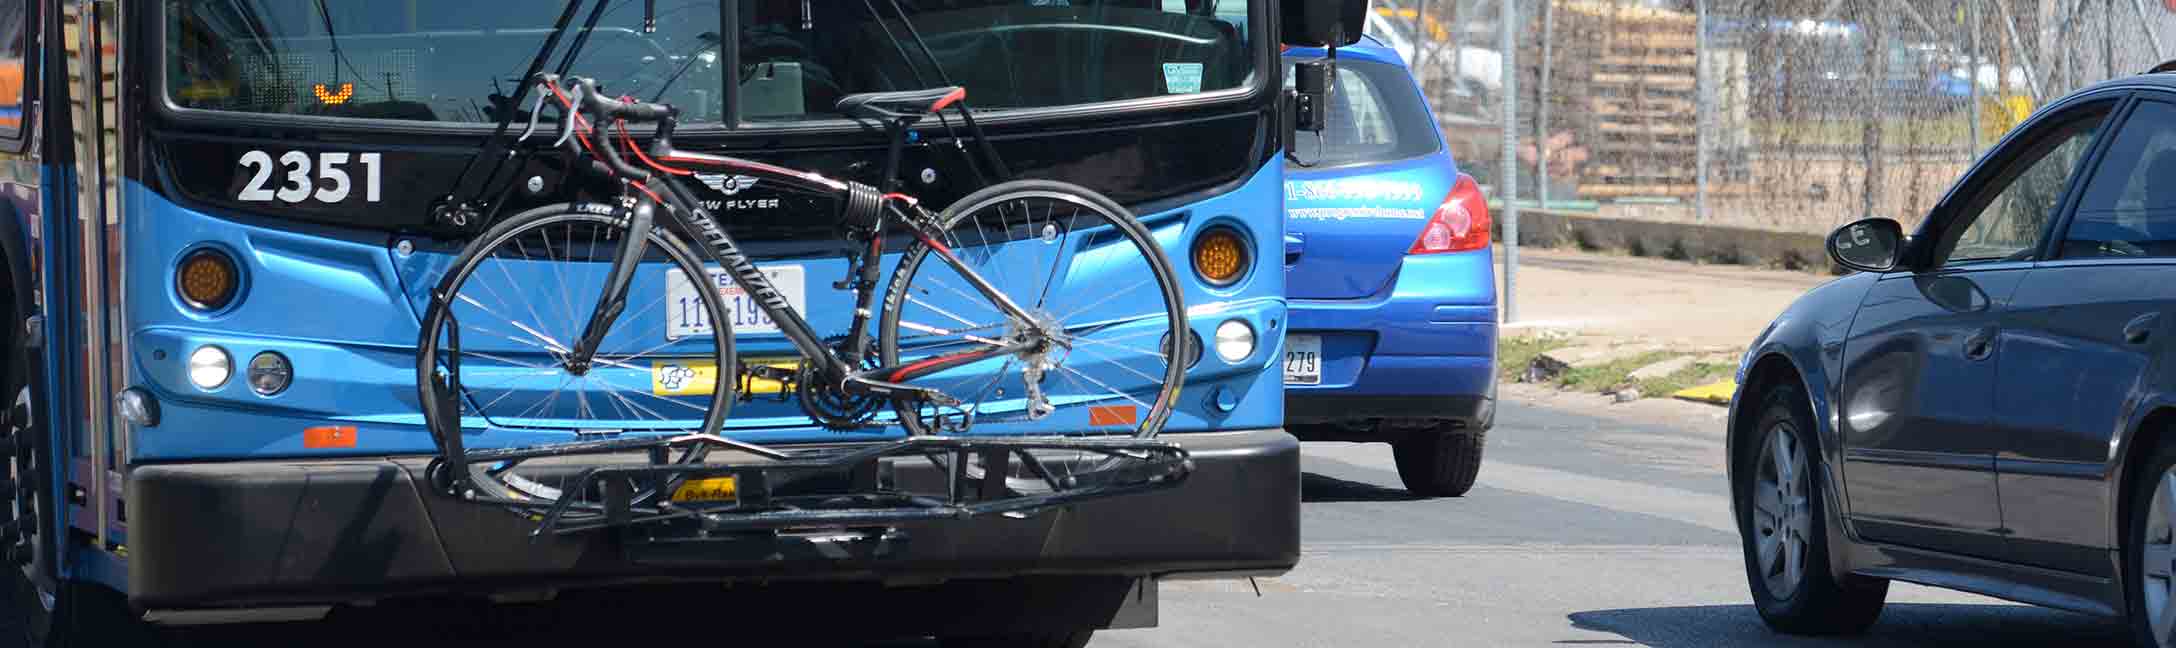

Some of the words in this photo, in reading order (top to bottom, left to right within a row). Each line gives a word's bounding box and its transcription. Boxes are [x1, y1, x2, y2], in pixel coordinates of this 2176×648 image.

[237, 149, 382, 203] 2351
[726, 198, 780, 210] FLYER
[687, 207, 789, 310] SPECIALIZED
[679, 296, 716, 328] 11
[1286, 351, 1316, 373] 279
